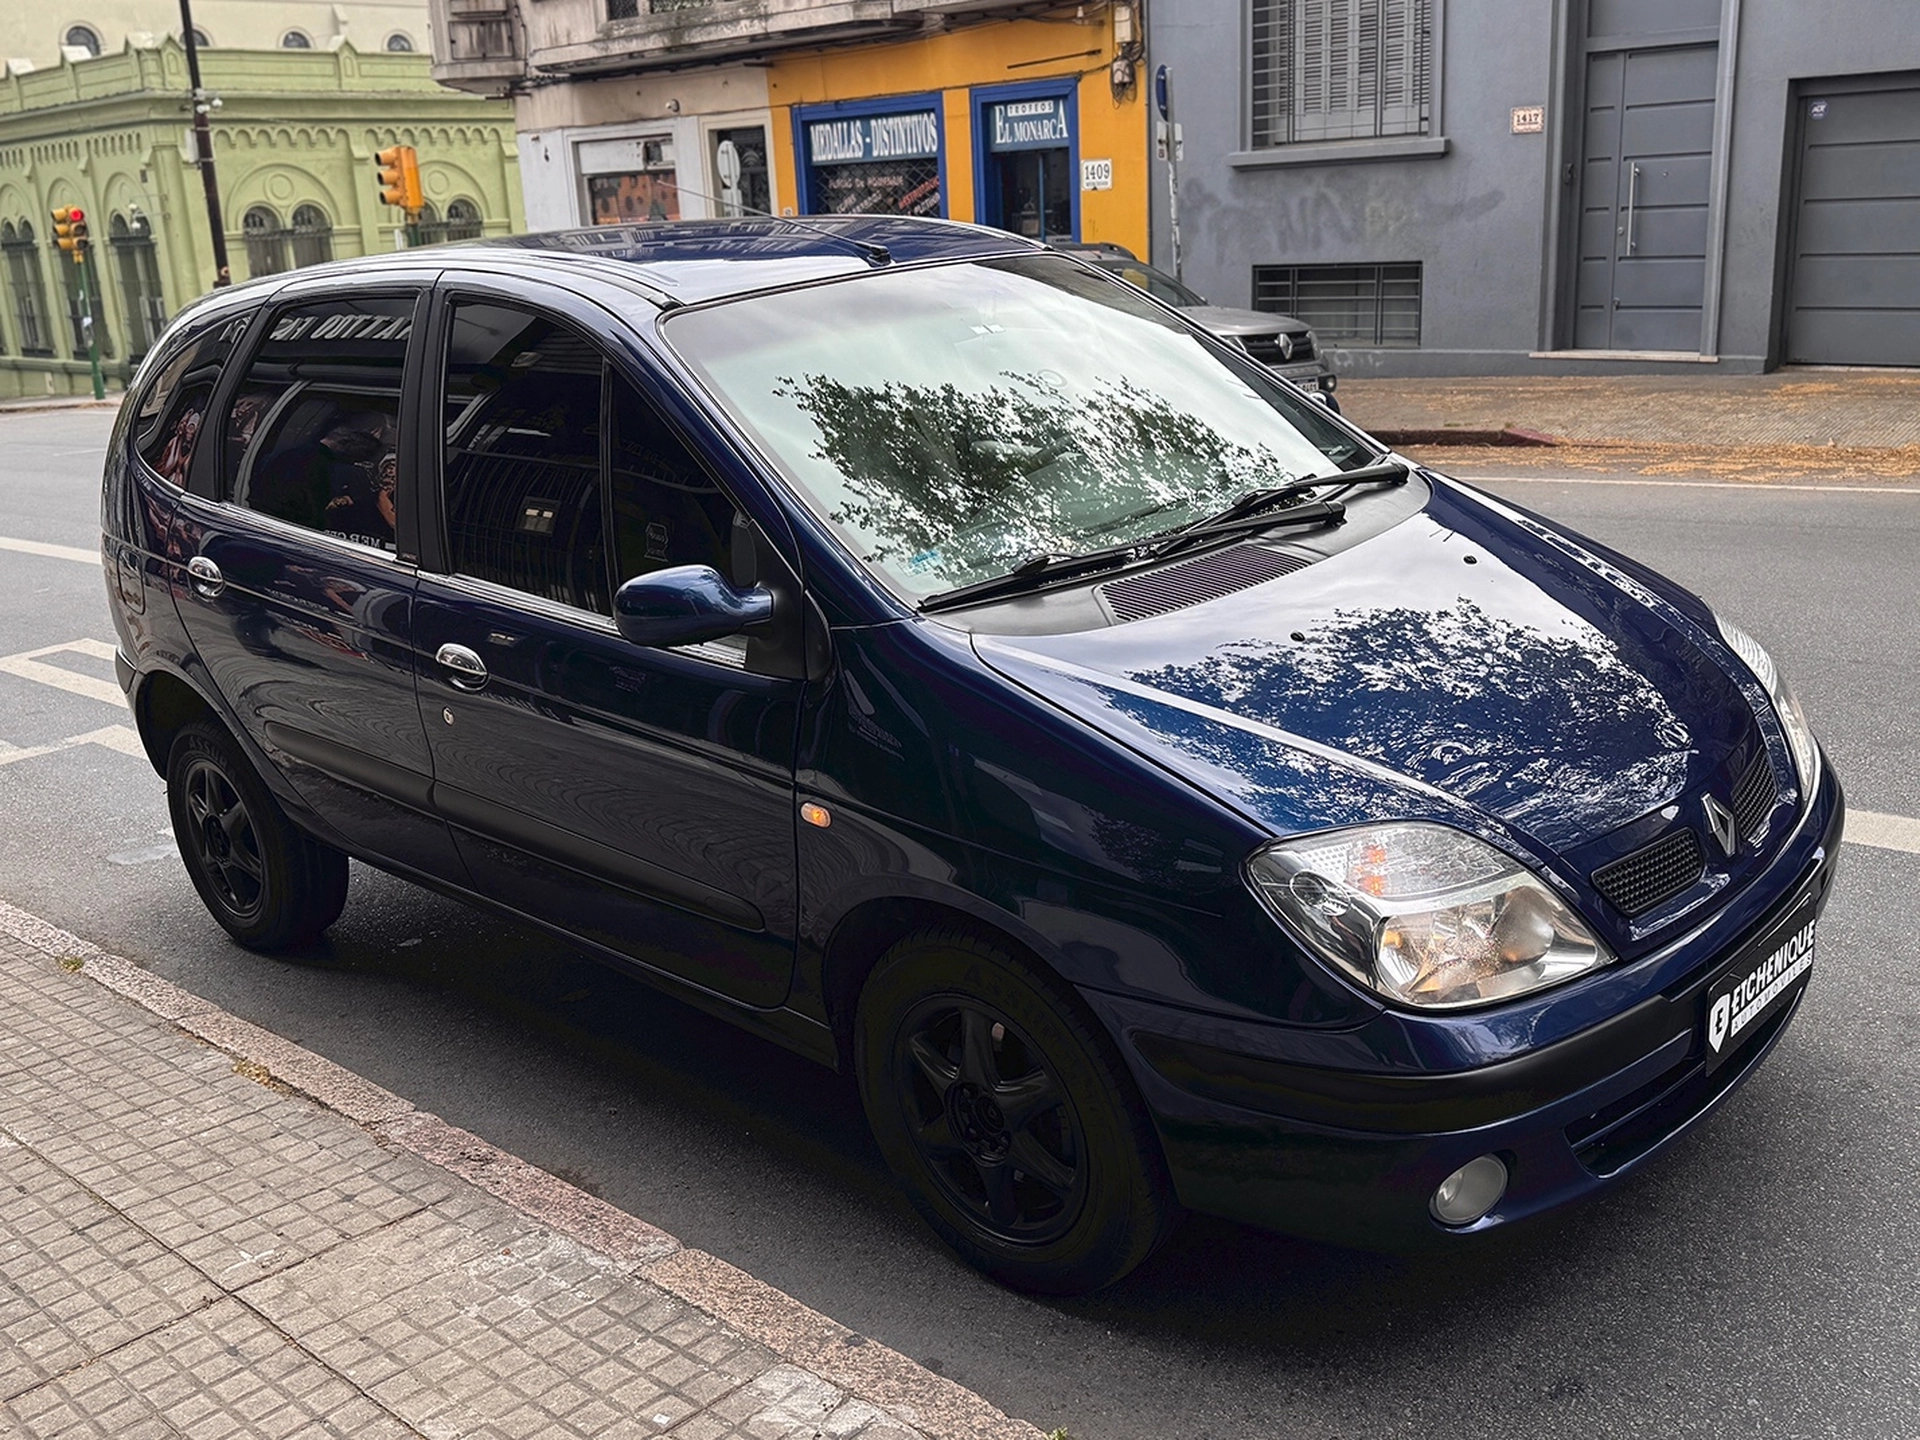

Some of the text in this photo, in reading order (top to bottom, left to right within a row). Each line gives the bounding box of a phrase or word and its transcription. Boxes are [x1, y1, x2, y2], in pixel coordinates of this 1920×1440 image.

[1008, 102, 1054, 114] TROFEOS
[1014, 100, 1069, 142] MONARCA
[1516, 113, 1539, 122] 1417
[810, 120, 864, 162] MEDALLAS
[870, 112, 938, 157] DISTINTIVOS
[1085, 163, 1110, 180] 1409
[1730, 919, 1816, 1017] ETCHENIQUE
